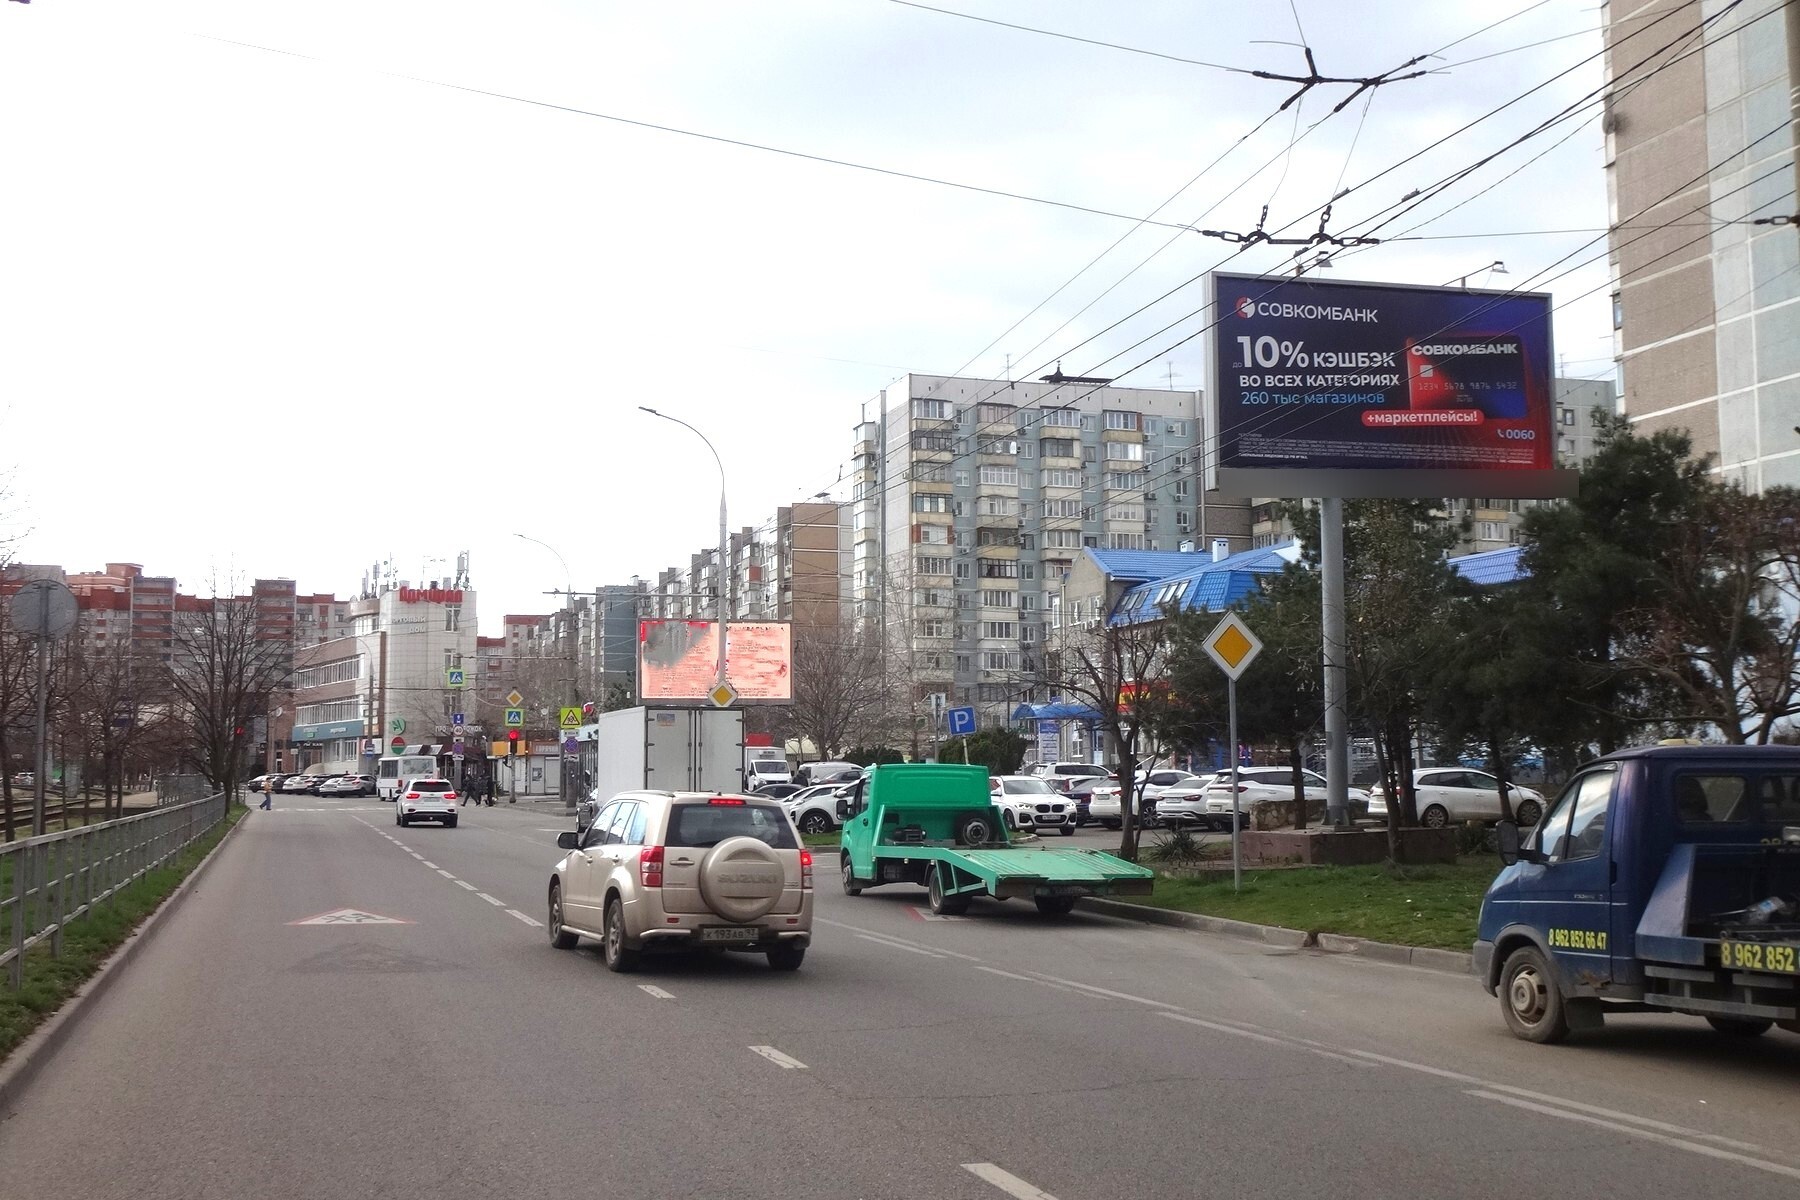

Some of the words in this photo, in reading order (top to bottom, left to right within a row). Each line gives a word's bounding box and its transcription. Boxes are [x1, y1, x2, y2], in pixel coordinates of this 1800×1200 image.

[1257, 302, 1379, 323] СОВКОМБАНК
[1237, 335, 1310, 369] 10%
[1313, 351, 1396, 368] КЭШБЭК
[1410, 343, 1519, 356] СОВКОМБАНК
[1239, 374, 1261, 388] ВО
[1264, 374, 1303, 388] ВСЕХ
[1306, 374, 1400, 388] КАТЕГОРИЯХ
[1240, 391, 1269, 405] 260
[1272, 394, 1300, 404] тыс
[1304, 393, 1385, 404] магазинов
[1366, 411, 1478, 426] +маркетплейсы!
[1505, 429, 1536, 440] 0060
[716, 873, 778, 884] SUZUKI
[1548, 928, 1555, 946] 8
[1555, 929, 1570, 947] 962
[1570, 930, 1585, 948] 852
[1585, 931, 1596, 949] 66
[1596, 932, 1607, 950] 47
[1721, 942, 1732, 966] 8
[1735, 944, 1763, 970] 962
[1766, 945, 1795, 972] 852
